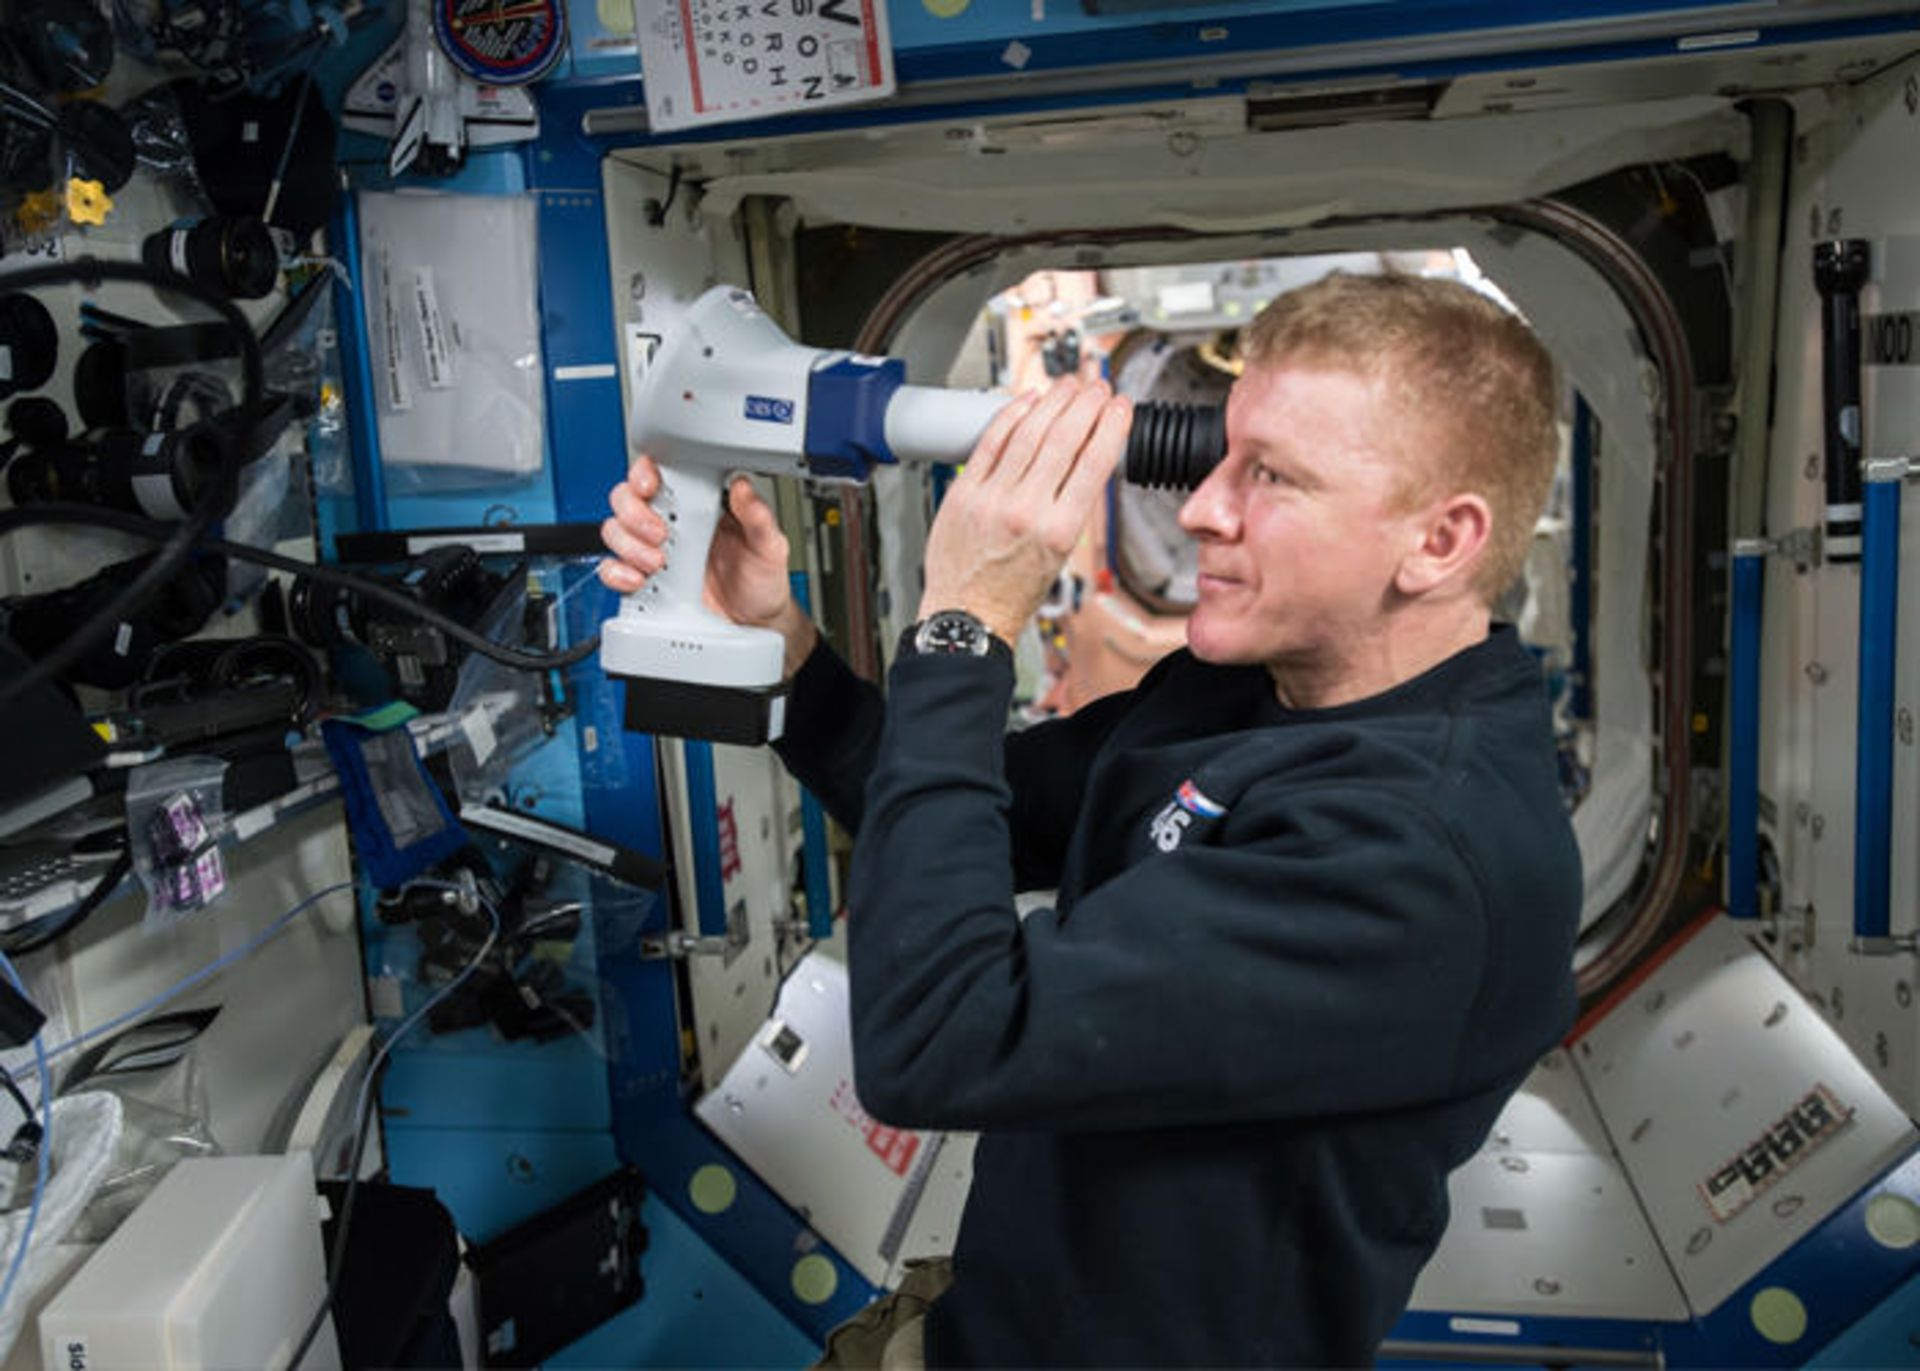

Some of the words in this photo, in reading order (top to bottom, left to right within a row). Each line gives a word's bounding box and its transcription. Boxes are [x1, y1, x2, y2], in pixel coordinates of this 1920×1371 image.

[735, 5, 752, 20] K
[761, 0, 779, 17] V
[764, 32, 783, 53] R
[797, 34, 818, 57] O
[768, 65, 786, 85] H
[801, 76, 824, 99] N
